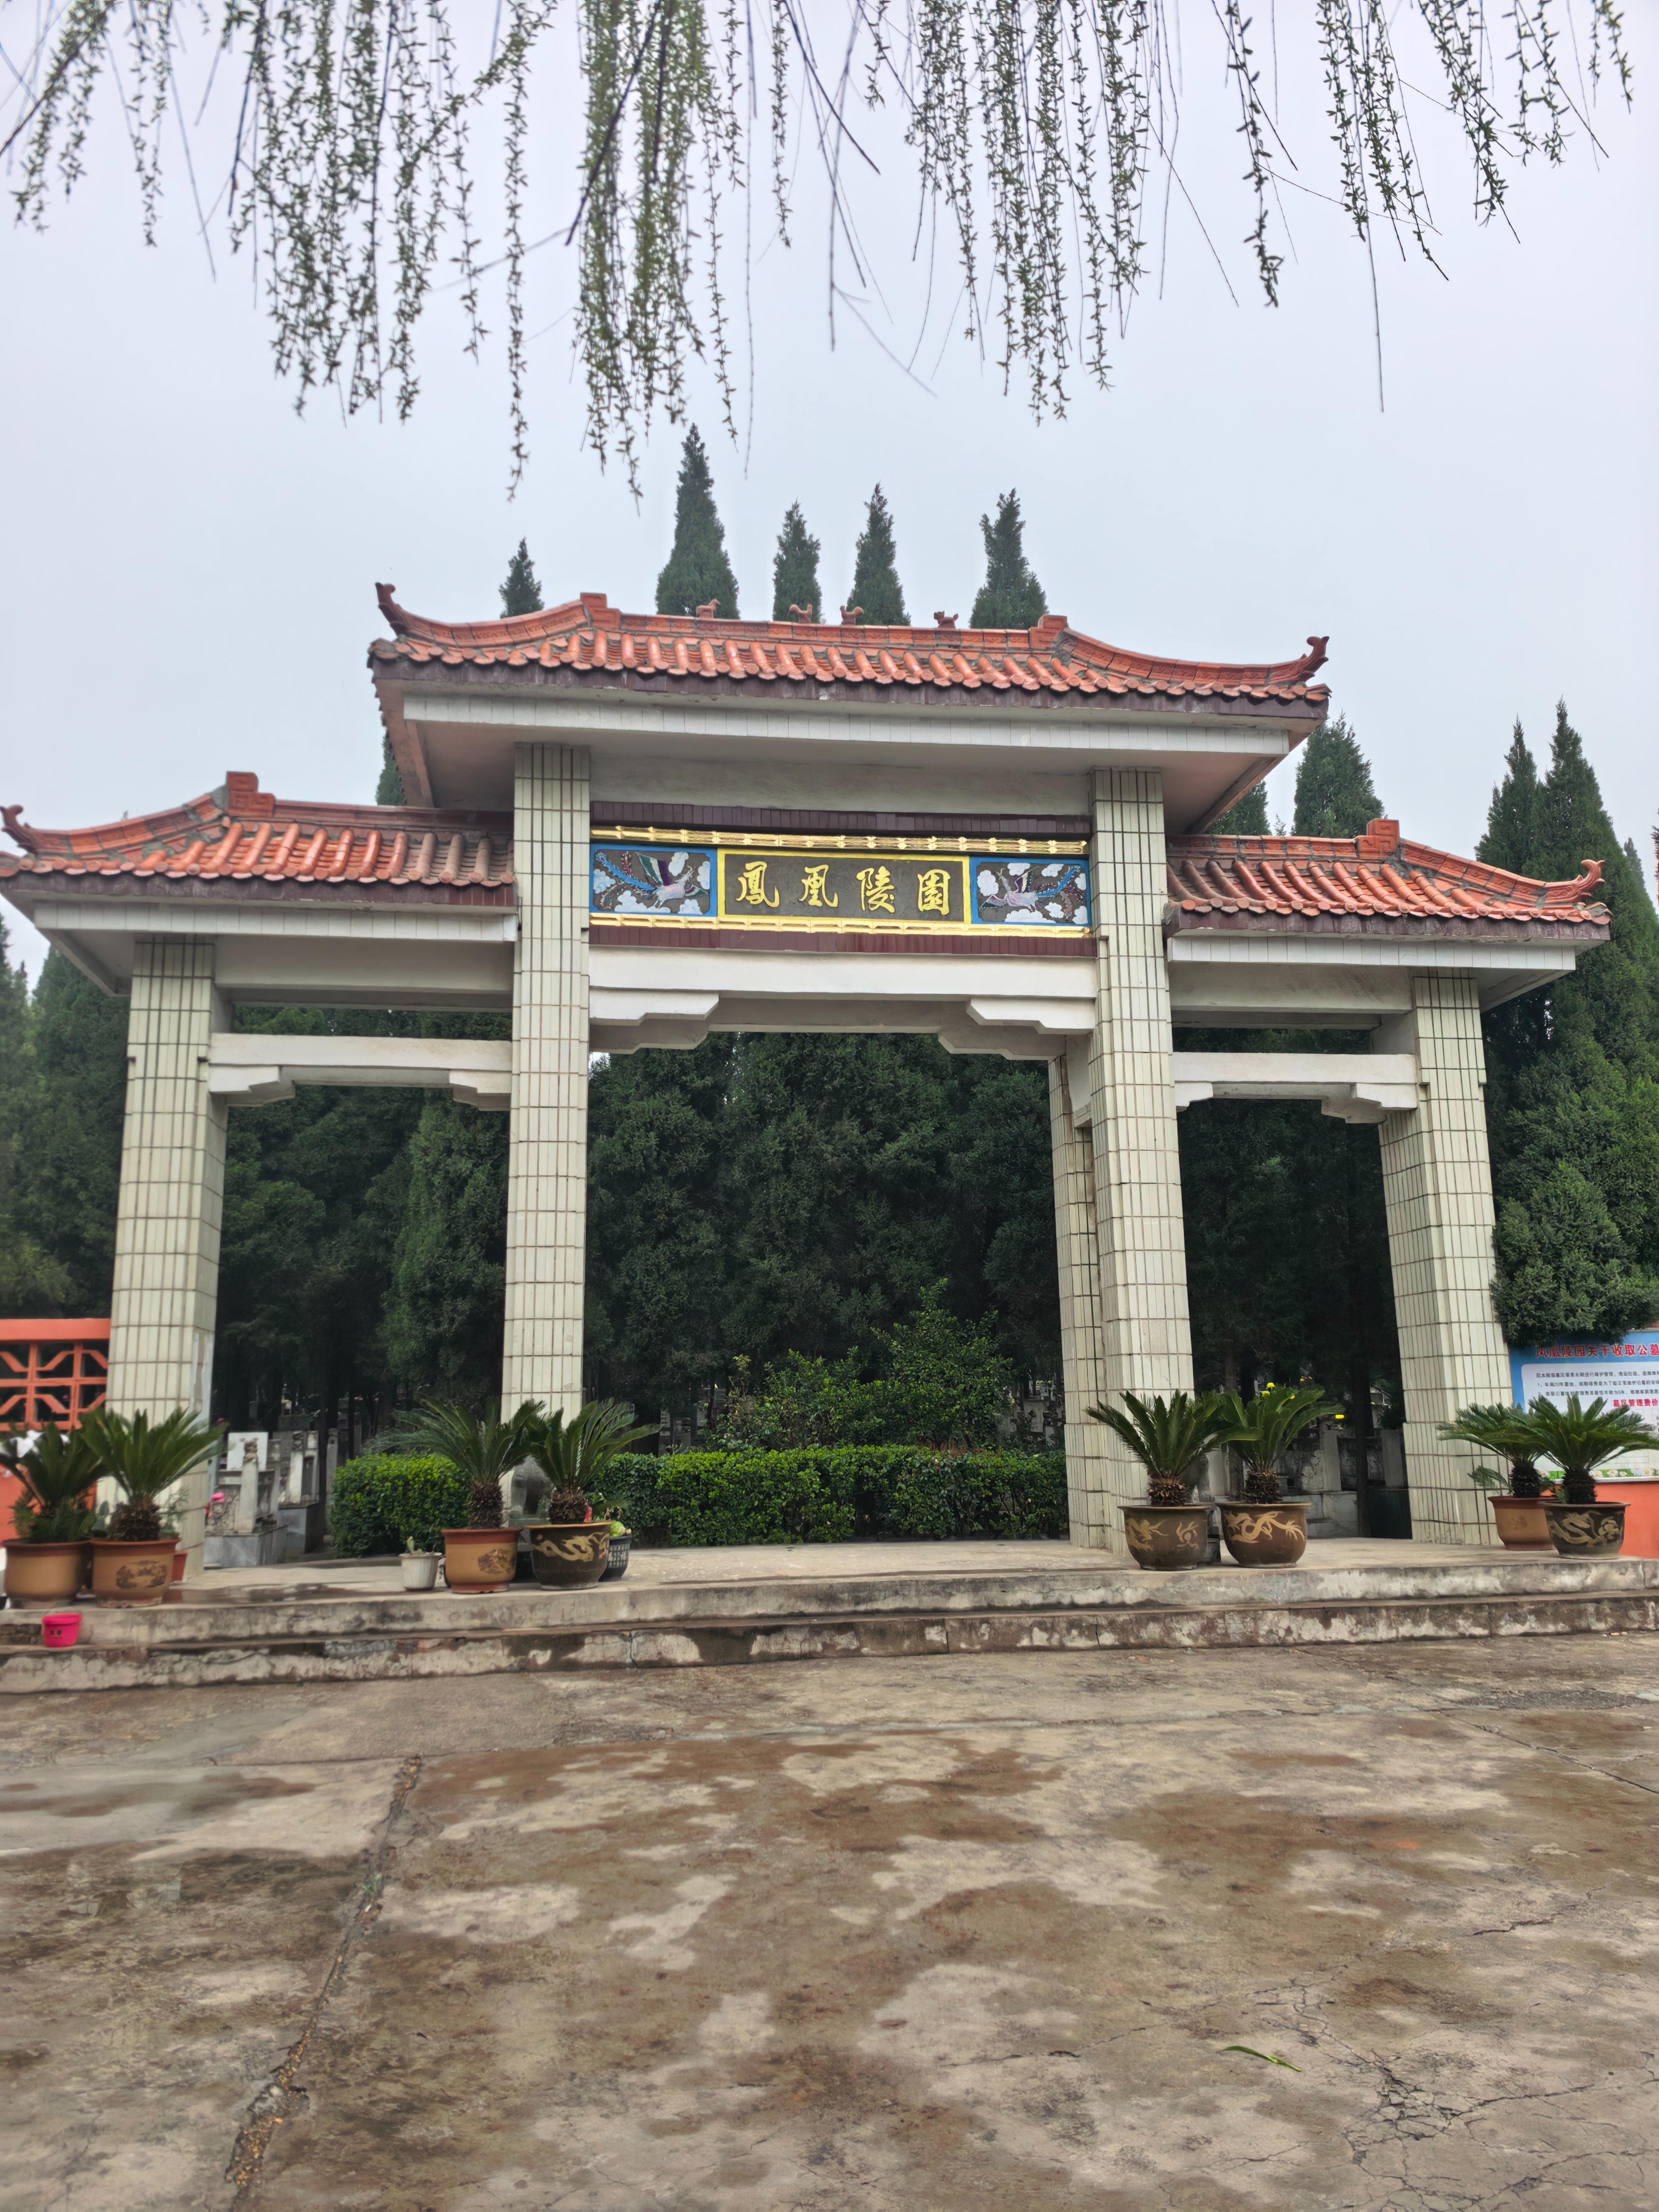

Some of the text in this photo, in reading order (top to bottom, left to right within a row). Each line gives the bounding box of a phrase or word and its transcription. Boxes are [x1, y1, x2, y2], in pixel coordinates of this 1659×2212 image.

[736, 861, 951, 916] 鳳凰陵園
[1536, 1344, 1659, 1357] 凤凰陵园关于收取公墓
